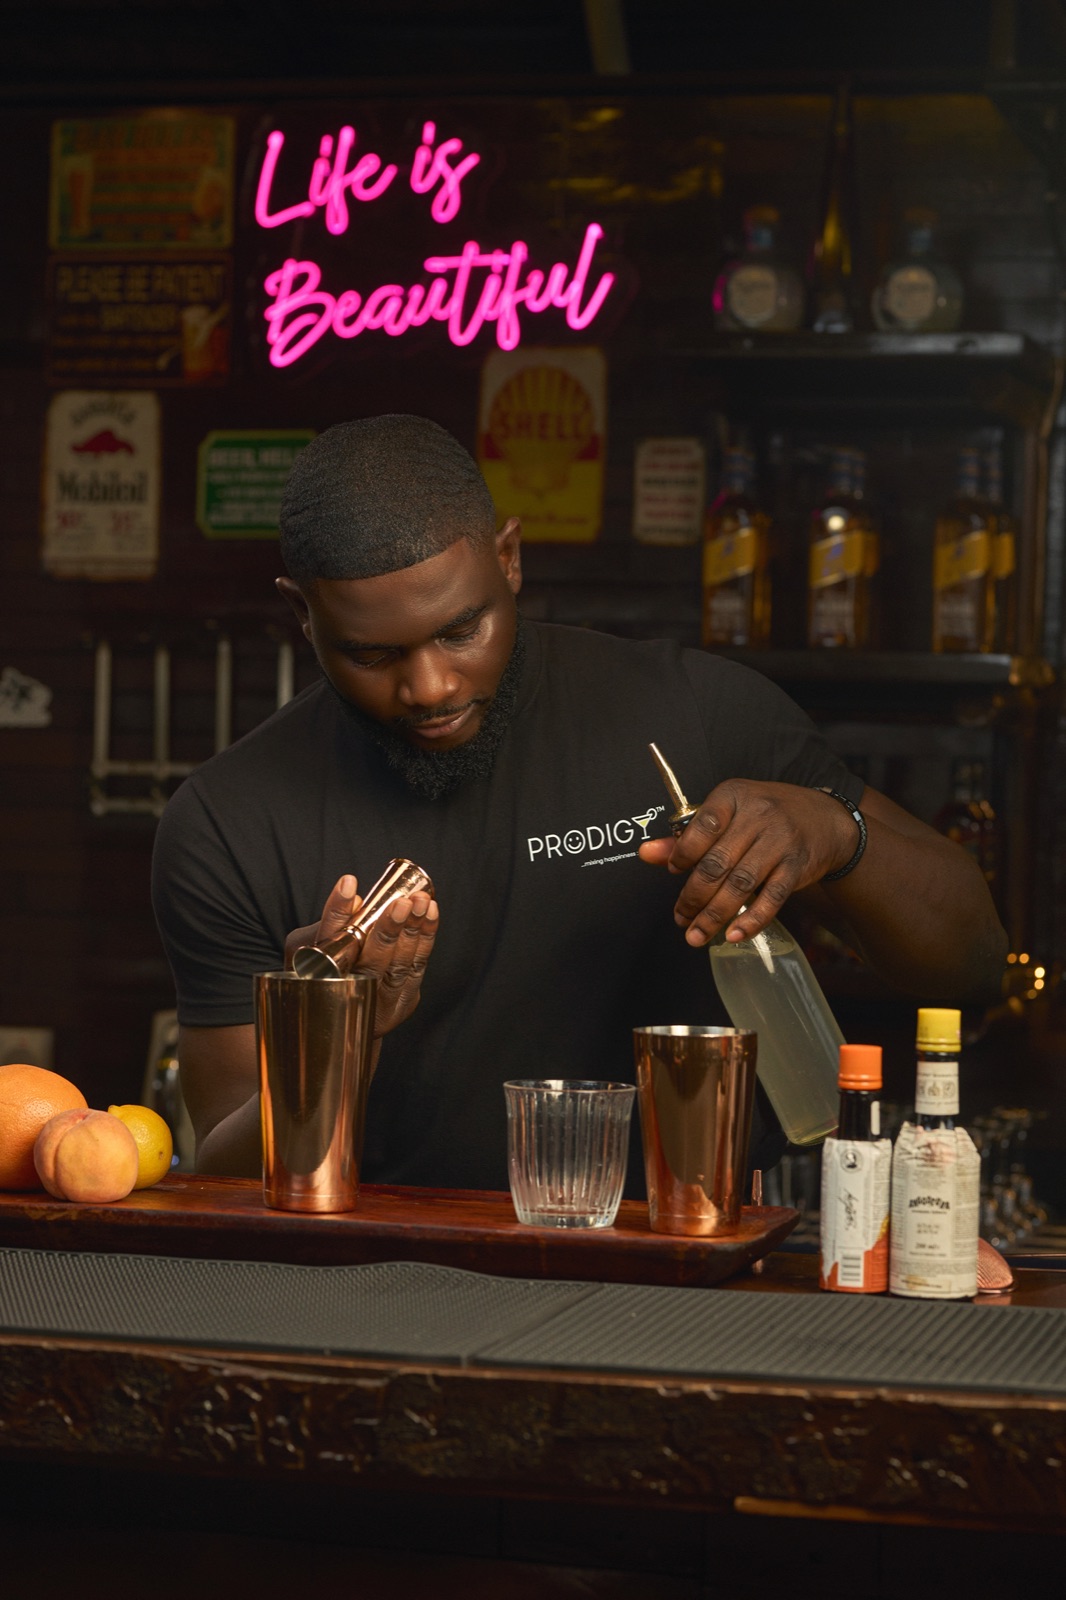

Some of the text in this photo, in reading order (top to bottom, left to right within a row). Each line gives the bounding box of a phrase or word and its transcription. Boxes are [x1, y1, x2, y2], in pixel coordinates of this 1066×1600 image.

[255, 121, 481, 235] Life is
[263, 222, 615, 369] Beautiful
[497, 410, 593, 441] SHELL
[527, 807, 658, 862] PRODIGY
